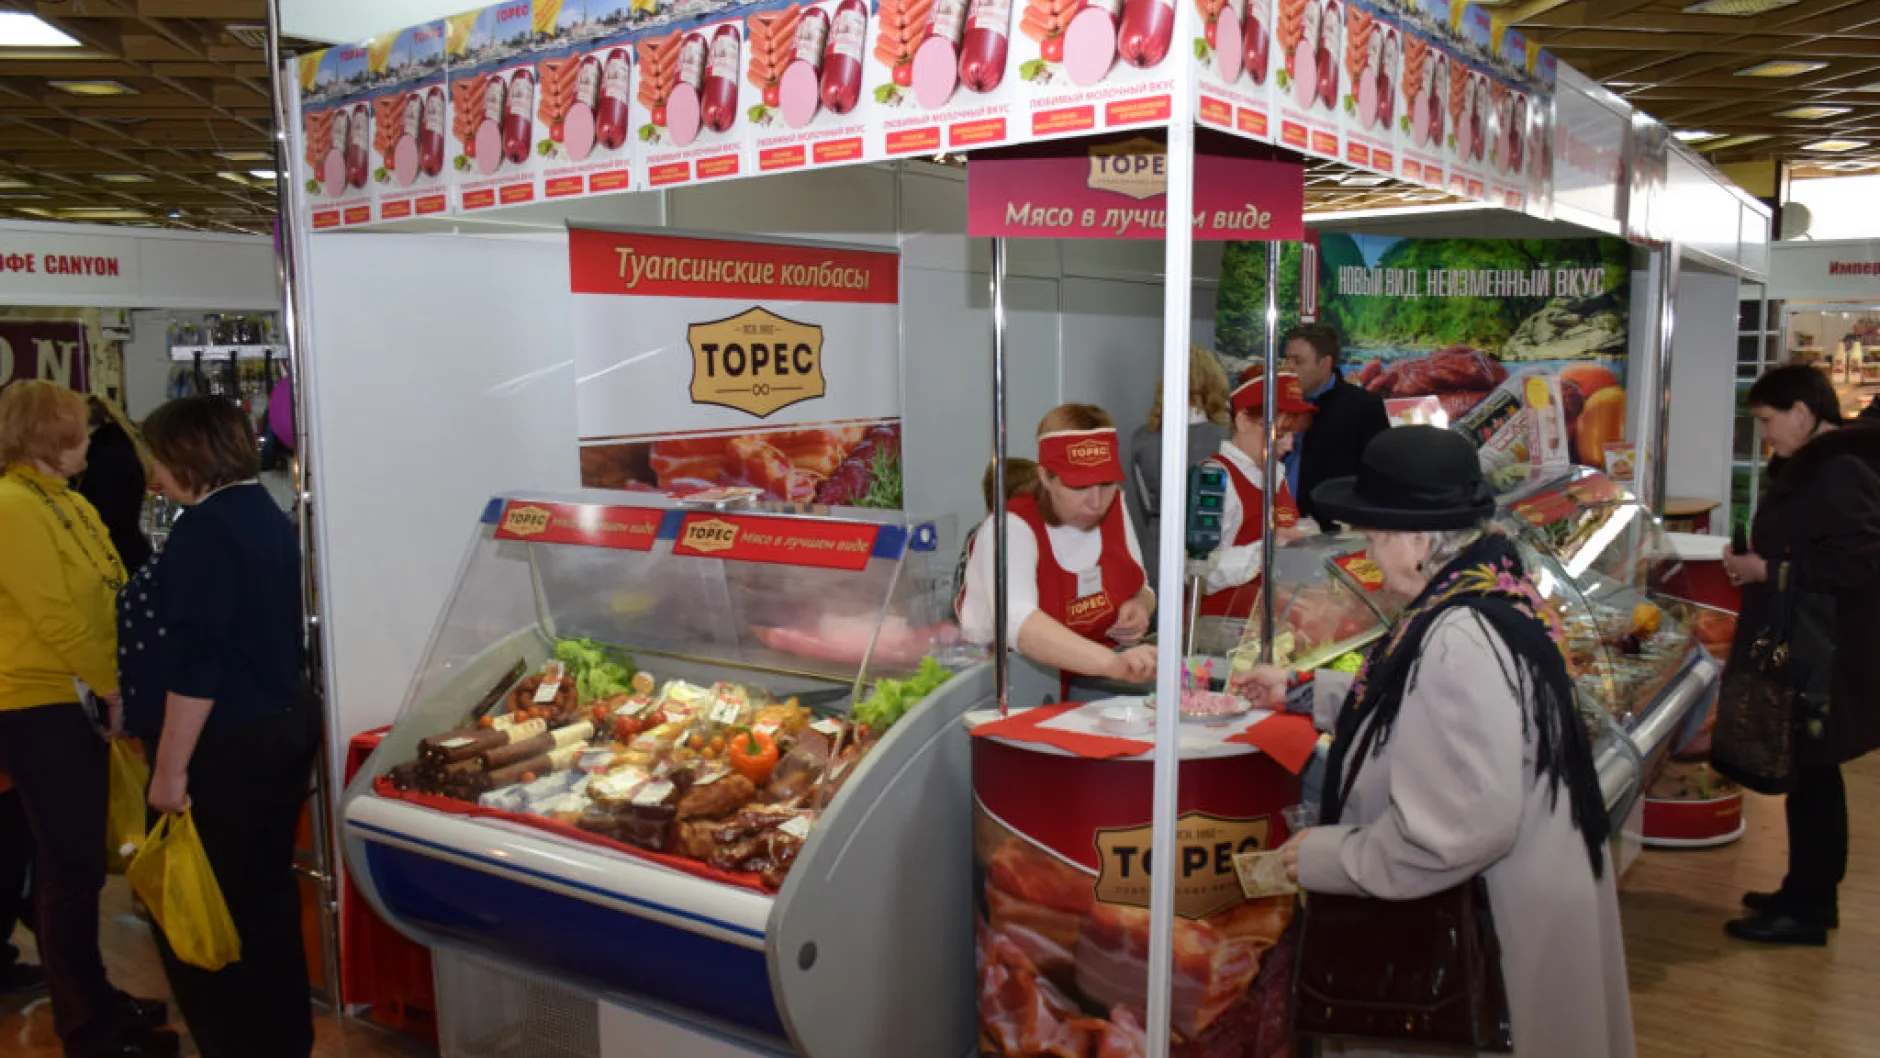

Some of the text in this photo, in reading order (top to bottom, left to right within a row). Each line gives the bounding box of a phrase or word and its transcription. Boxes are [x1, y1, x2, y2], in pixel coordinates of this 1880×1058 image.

[1149, 79, 1176, 92] ВКУС
[1099, 154, 1165, 176] ТОРЕ
[1005, 201, 1272, 236] Мясо в лучшм виде
[44, 253, 119, 277] CANYON
[614, 247, 870, 290] Туапсинские колбасы
[1338, 261, 1383, 297] НОВЫЙ
[1427, 262, 1549, 298] НЕИЗМЕННЫЙ
[1555, 267, 1606, 298] ВКУС
[701, 343, 814, 378] ТОРЕС
[689, 526, 735, 541] ТОРЕС
